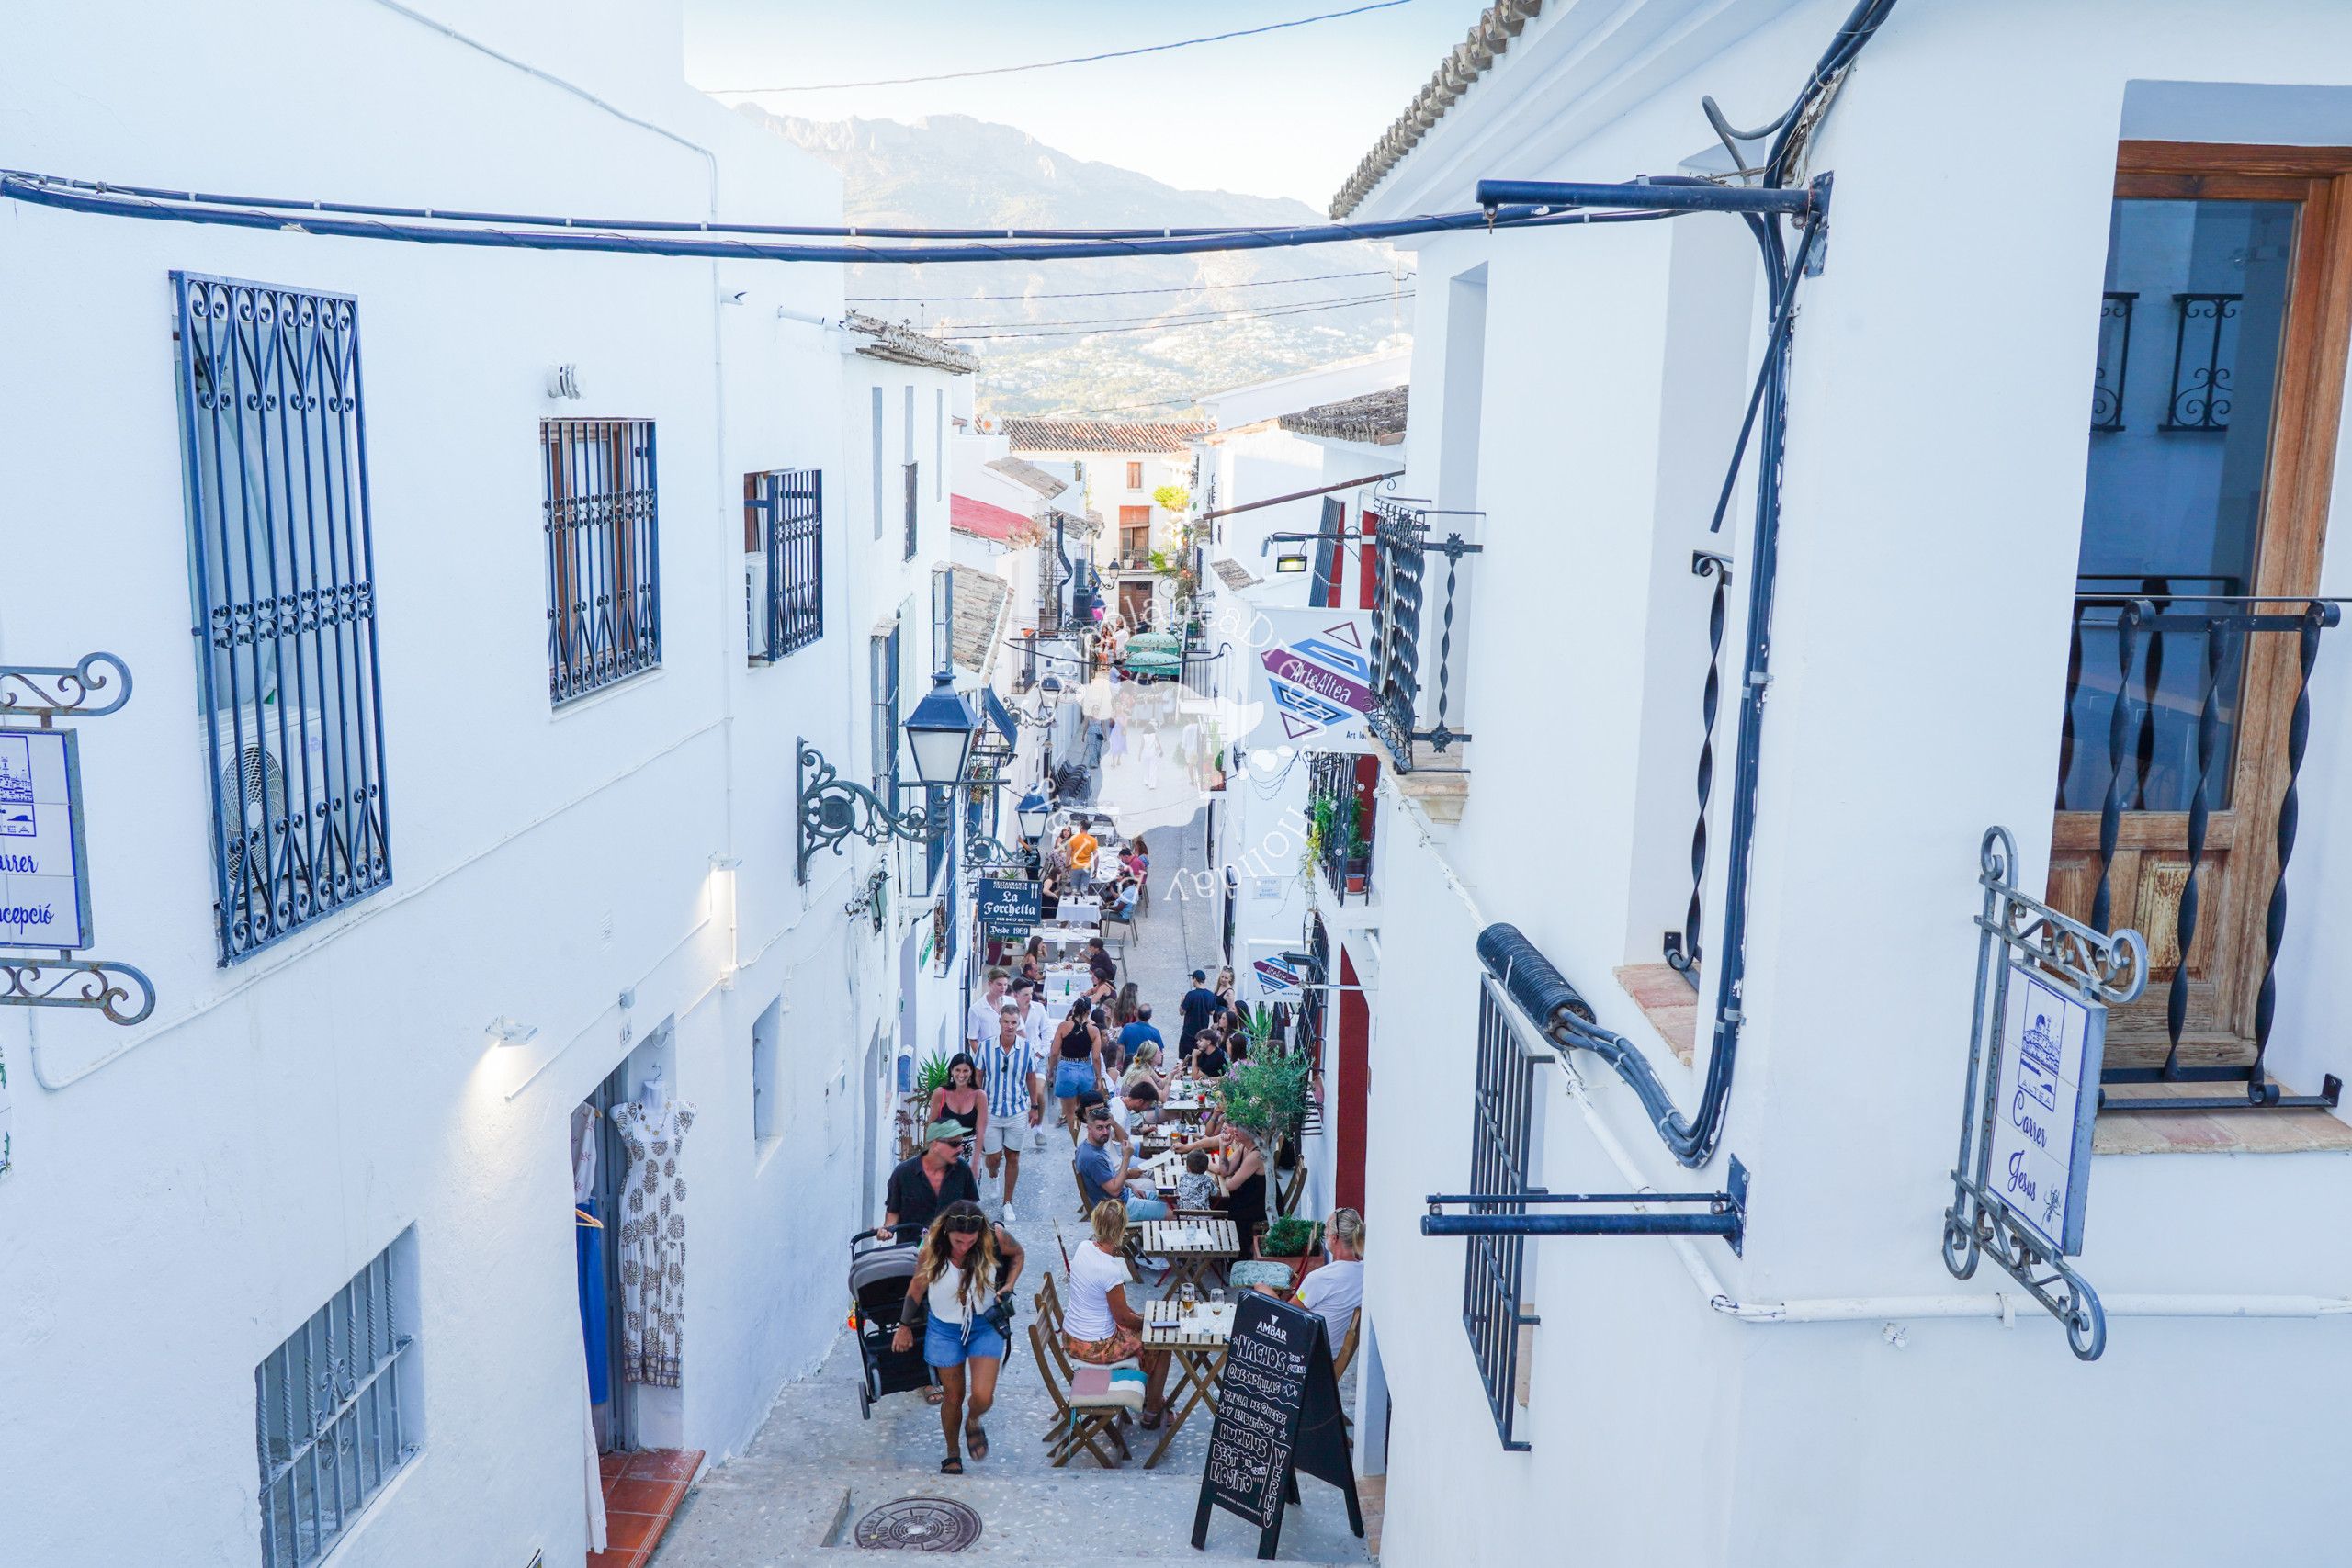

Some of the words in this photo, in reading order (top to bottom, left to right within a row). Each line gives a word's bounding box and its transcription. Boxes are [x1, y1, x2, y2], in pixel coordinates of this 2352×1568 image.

[1290, 661, 1351, 703] ArteAltea
[983, 901, 1036, 917] Forchetta
[1001, 890, 1019, 903] La
[0, 903, 55, 935] cepció
[989, 925, 1010, 935] Desde
[2021, 1079, 2052, 1105] ALTEA
[2012, 1089, 2047, 1148] Carrer
[2007, 1149, 2037, 1201] Jesus
[1256, 1320, 1287, 1341] AMBAR
[1236, 1334, 1287, 1371] NACHOS
[1227, 1363, 1282, 1394] QUESADILLAS
[1223, 1388, 1249, 1408] TABLA
[1250, 1399, 1261, 1412] DE
[1260, 1402, 1288, 1426] QUESOS
[1234, 1408, 1275, 1437] EMBUTIDOS
[1212, 1443, 1239, 1467] BEST
[1219, 1422, 1268, 1458] HUMMUS
[1210, 1461, 1253, 1493] MOJITO
[1263, 1447, 1287, 1529] VERMU
